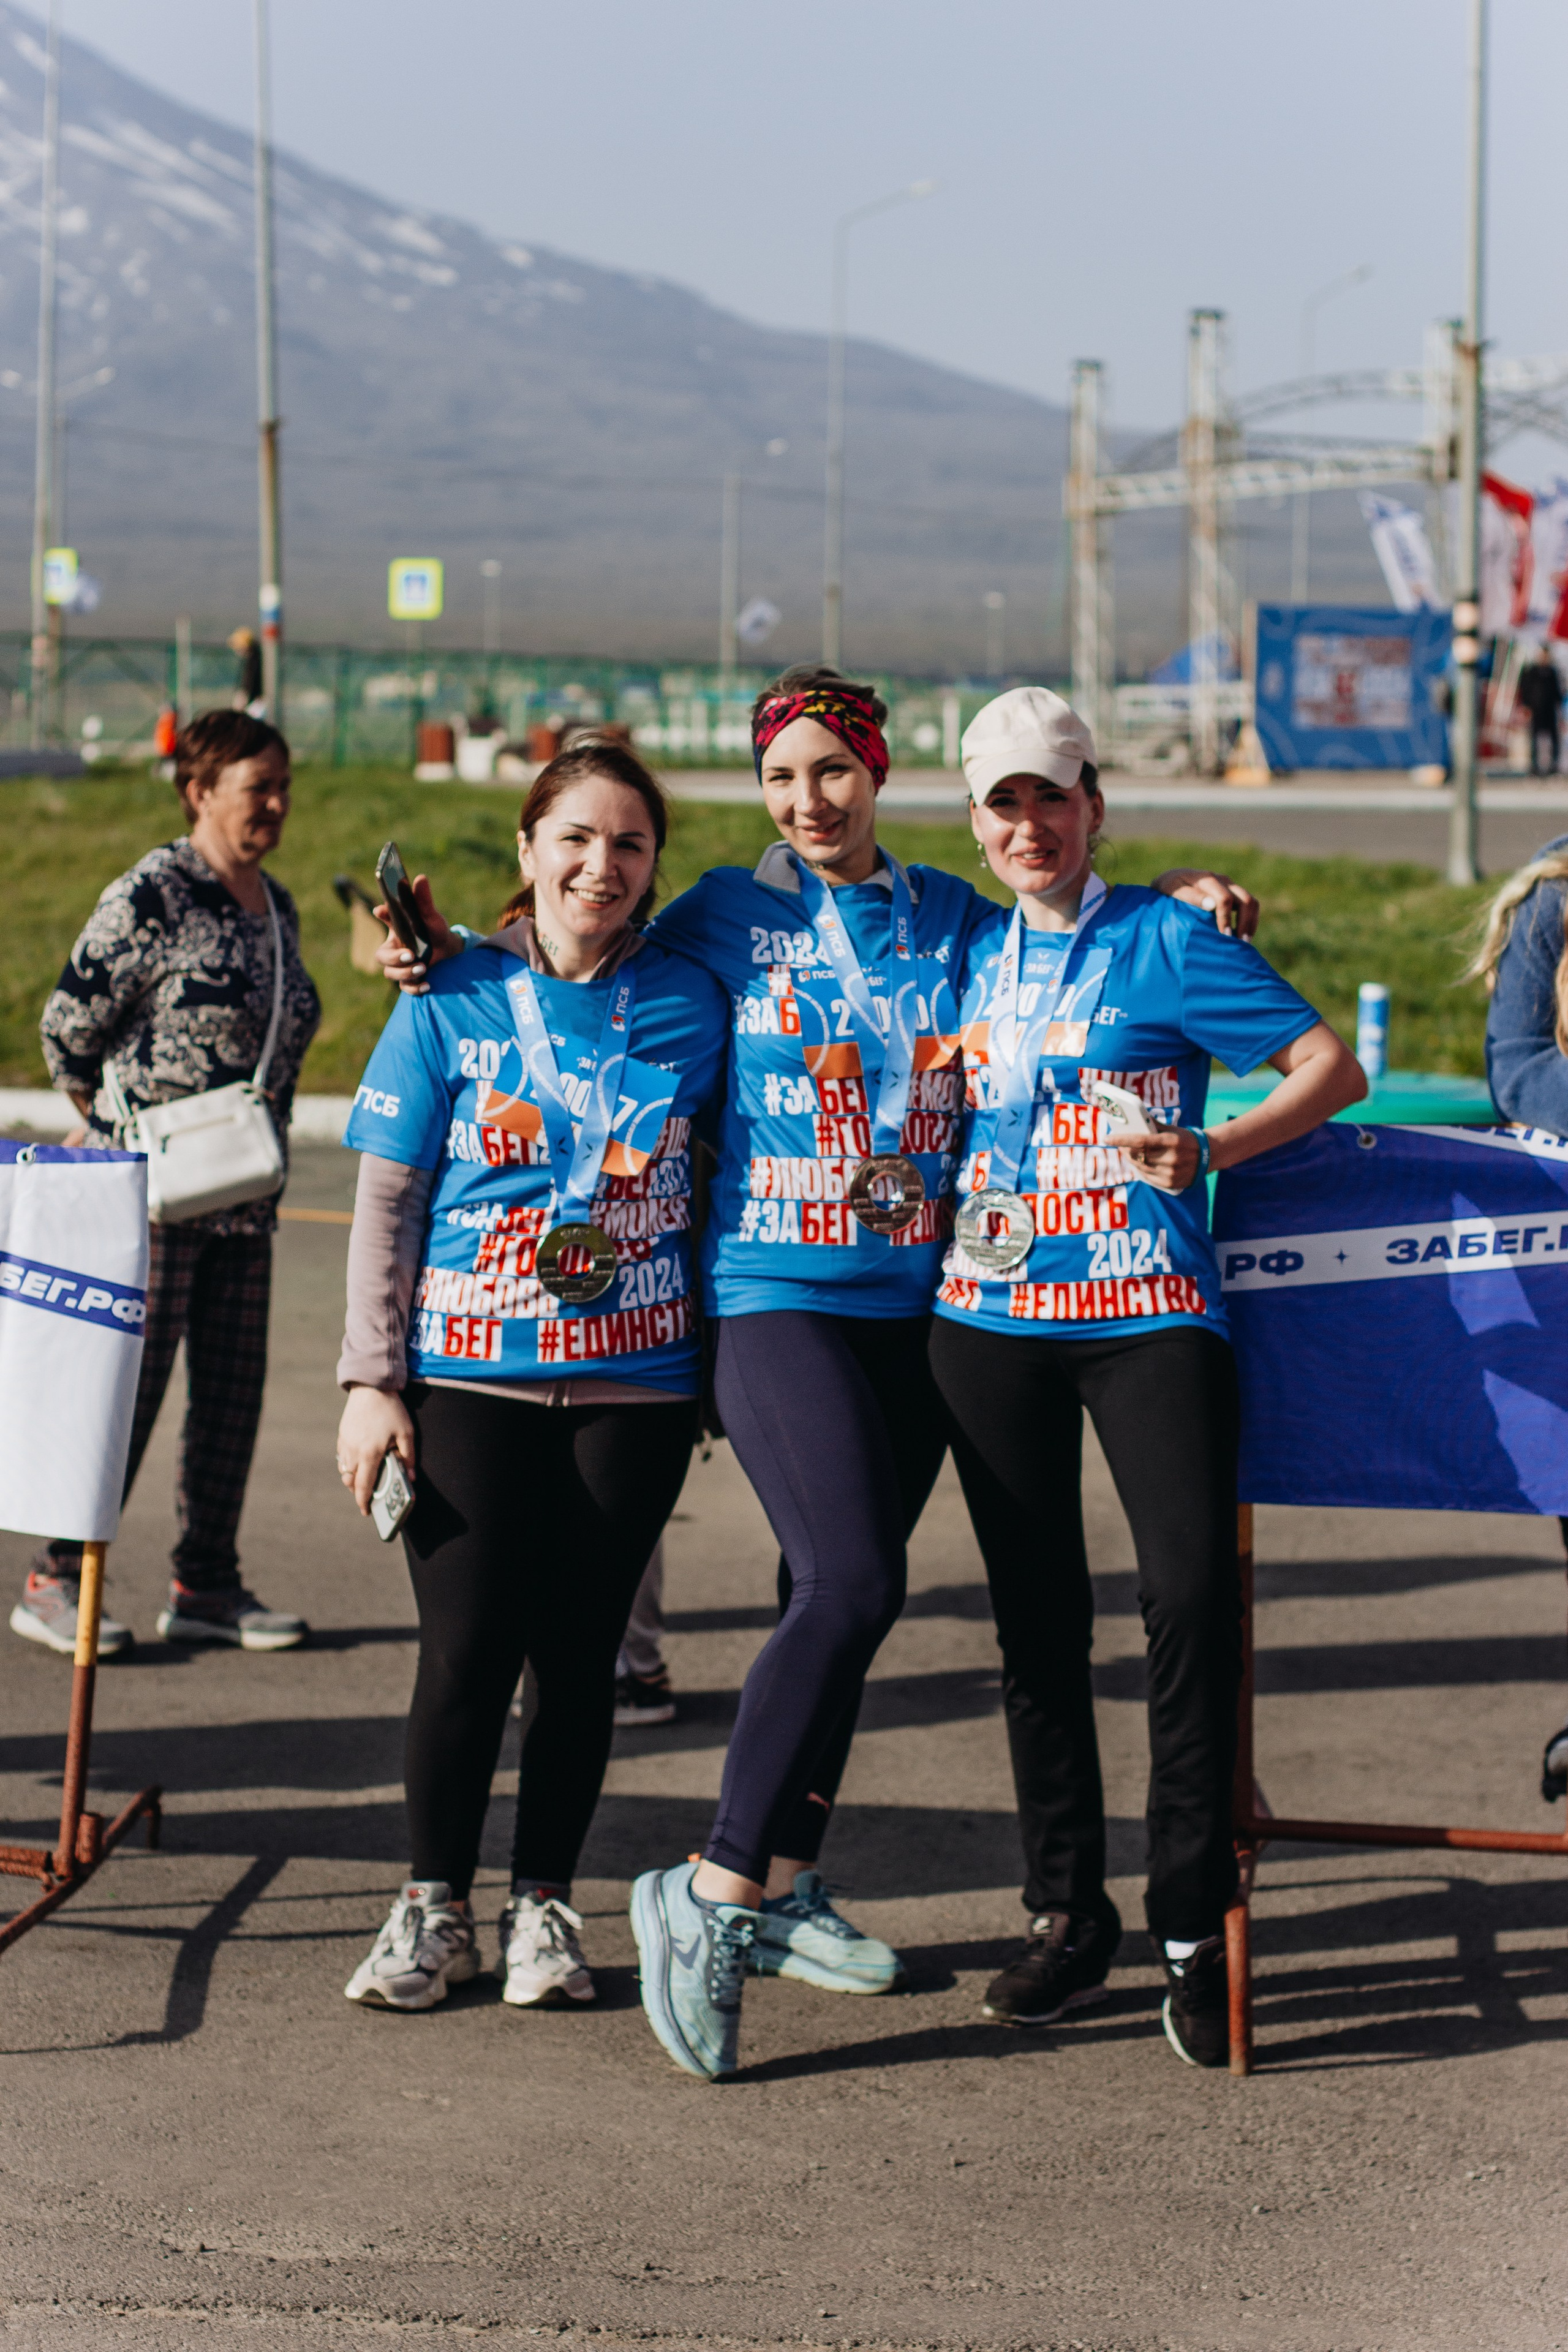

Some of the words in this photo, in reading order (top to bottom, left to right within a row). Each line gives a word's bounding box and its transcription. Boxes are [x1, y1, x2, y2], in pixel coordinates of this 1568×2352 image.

[826, 930, 846, 959] ПСБ
[898, 916, 908, 943] ПСБ
[750, 926, 832, 966] 2024
[812, 970, 835, 979] ПСБ
[516, 995, 535, 1025] ПСБ
[616, 986, 630, 1014] ПСБ
[548, 1033, 567, 1047] СБ
[459, 1038, 512, 1080] 20
[353, 1084, 401, 1118] ПСБ
[739, 1200, 858, 1246] #ЗАБЕГ
[1087, 1228, 1172, 1279] 2024
[1226, 1250, 1304, 1280] РФ
[619, 1253, 685, 1310] 2024
